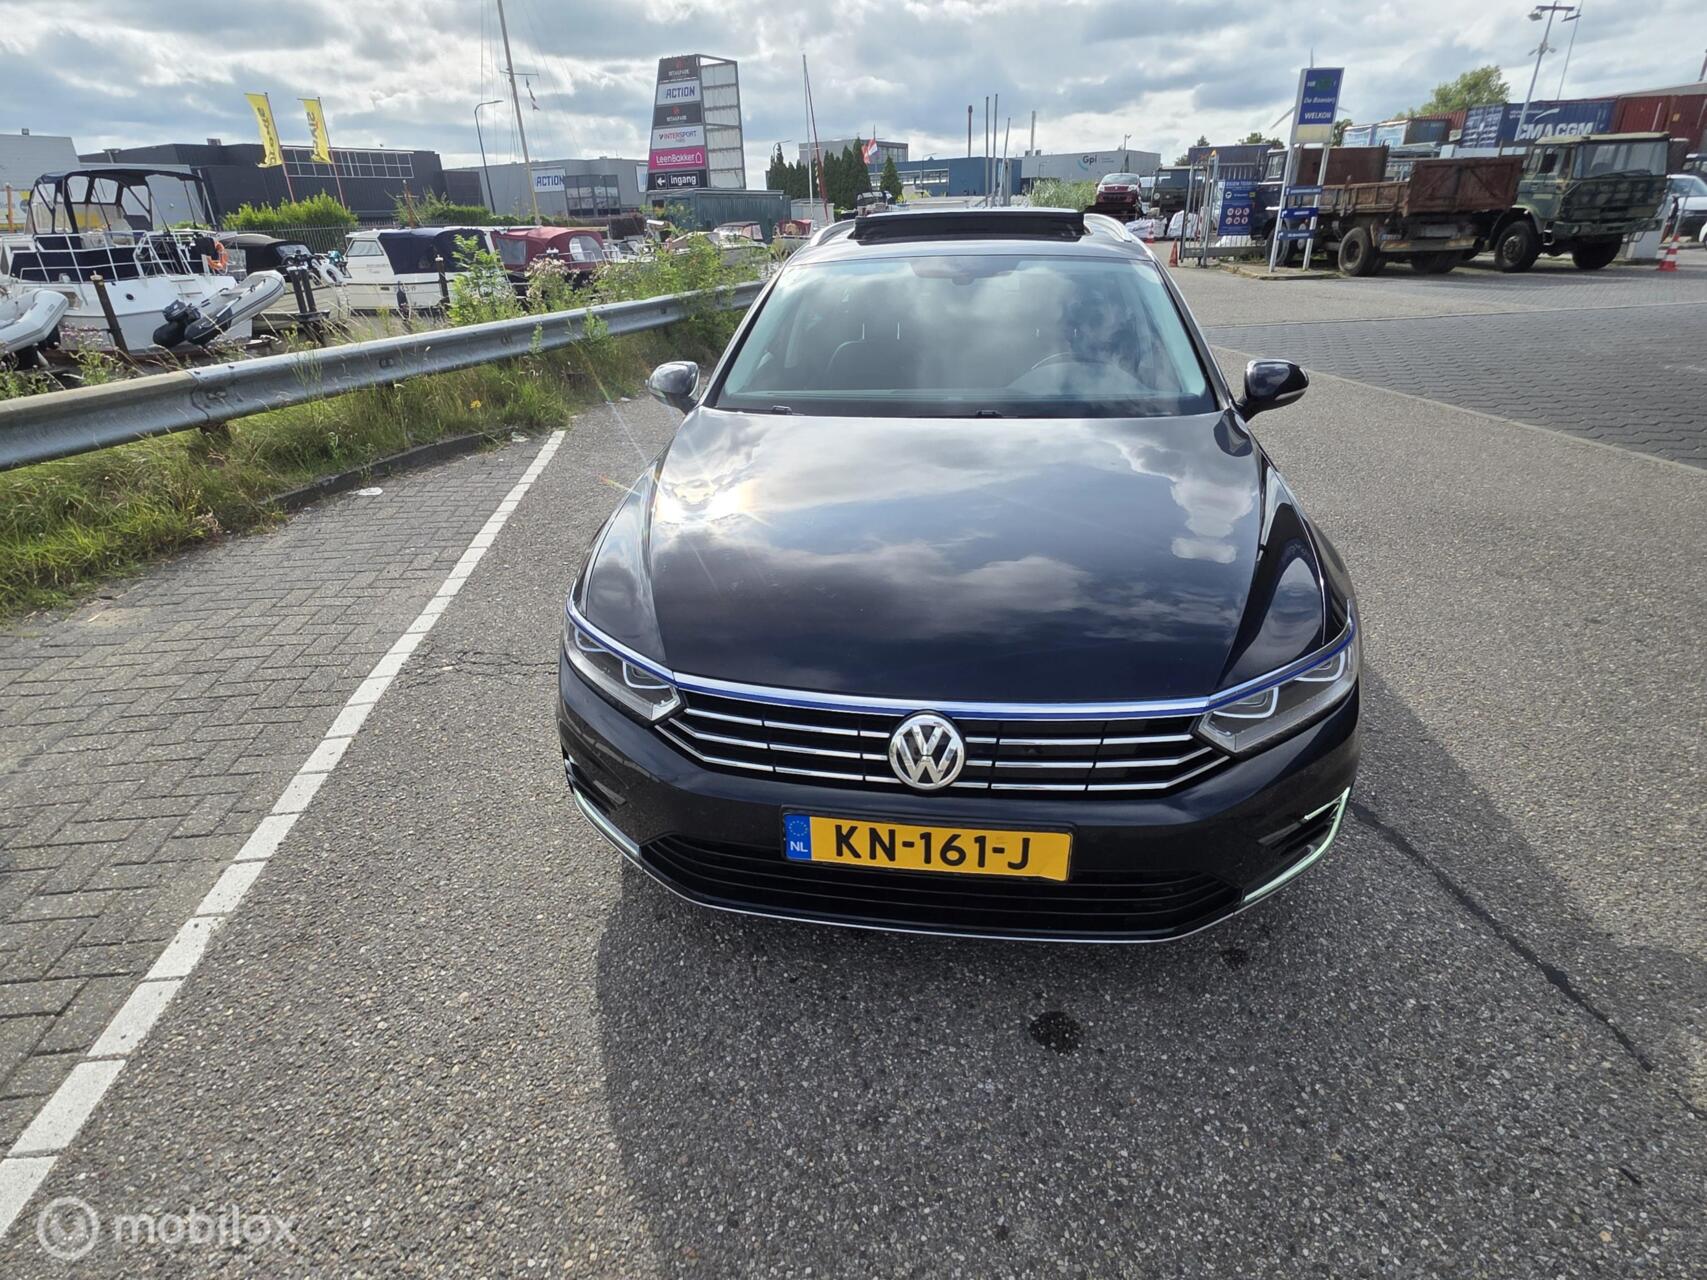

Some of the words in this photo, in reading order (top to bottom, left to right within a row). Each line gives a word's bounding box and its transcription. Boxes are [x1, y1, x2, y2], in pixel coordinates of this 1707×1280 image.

[666, 86, 695, 99] ACTION
[664, 131, 696, 140] INTERSPORT
[1082, 154, 1097, 165] Gpi
[536, 175, 565, 187] ACTION
[670, 175, 697, 185] ingang
[790, 840, 808, 853] NL
[834, 824, 1031, 870] KN-161-J
